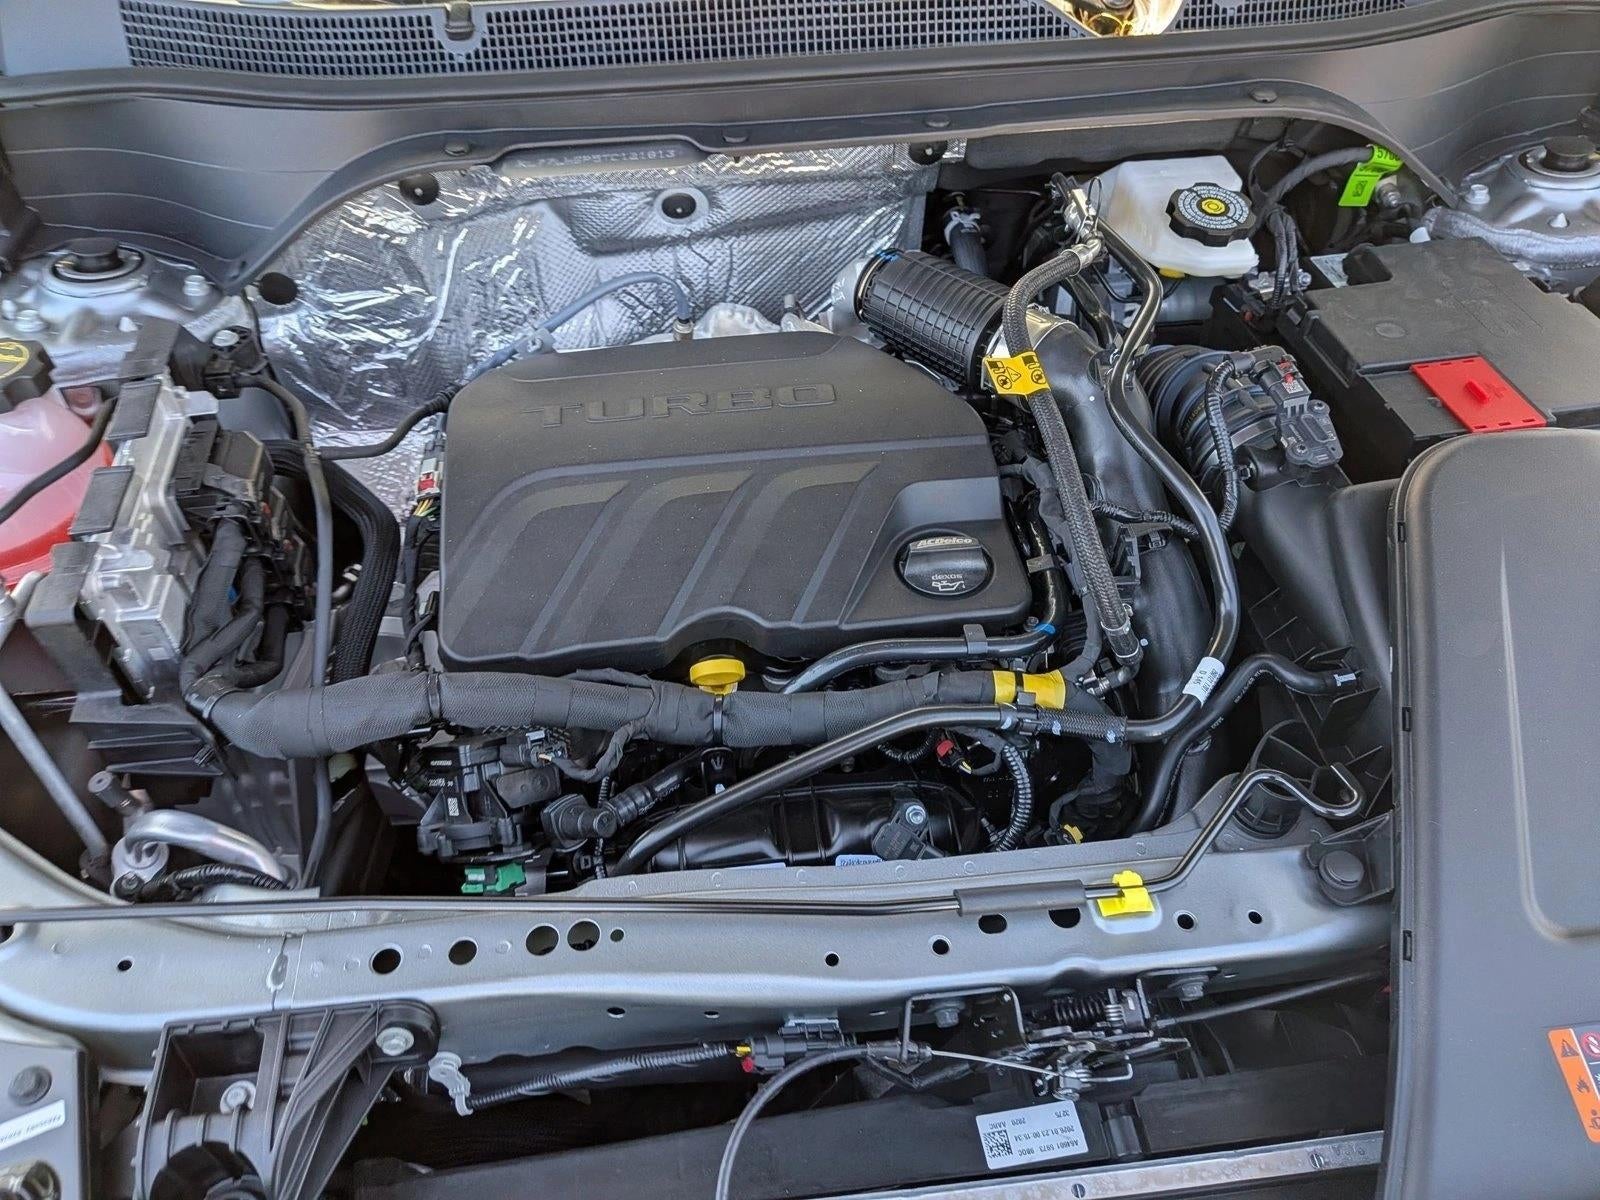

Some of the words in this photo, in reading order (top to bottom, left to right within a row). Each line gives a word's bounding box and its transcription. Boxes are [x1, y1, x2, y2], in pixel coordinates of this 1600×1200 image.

[522, 383, 836, 428] TURBO
[917, 537, 973, 549] ACDelco
[931, 573, 963, 581] dexos
